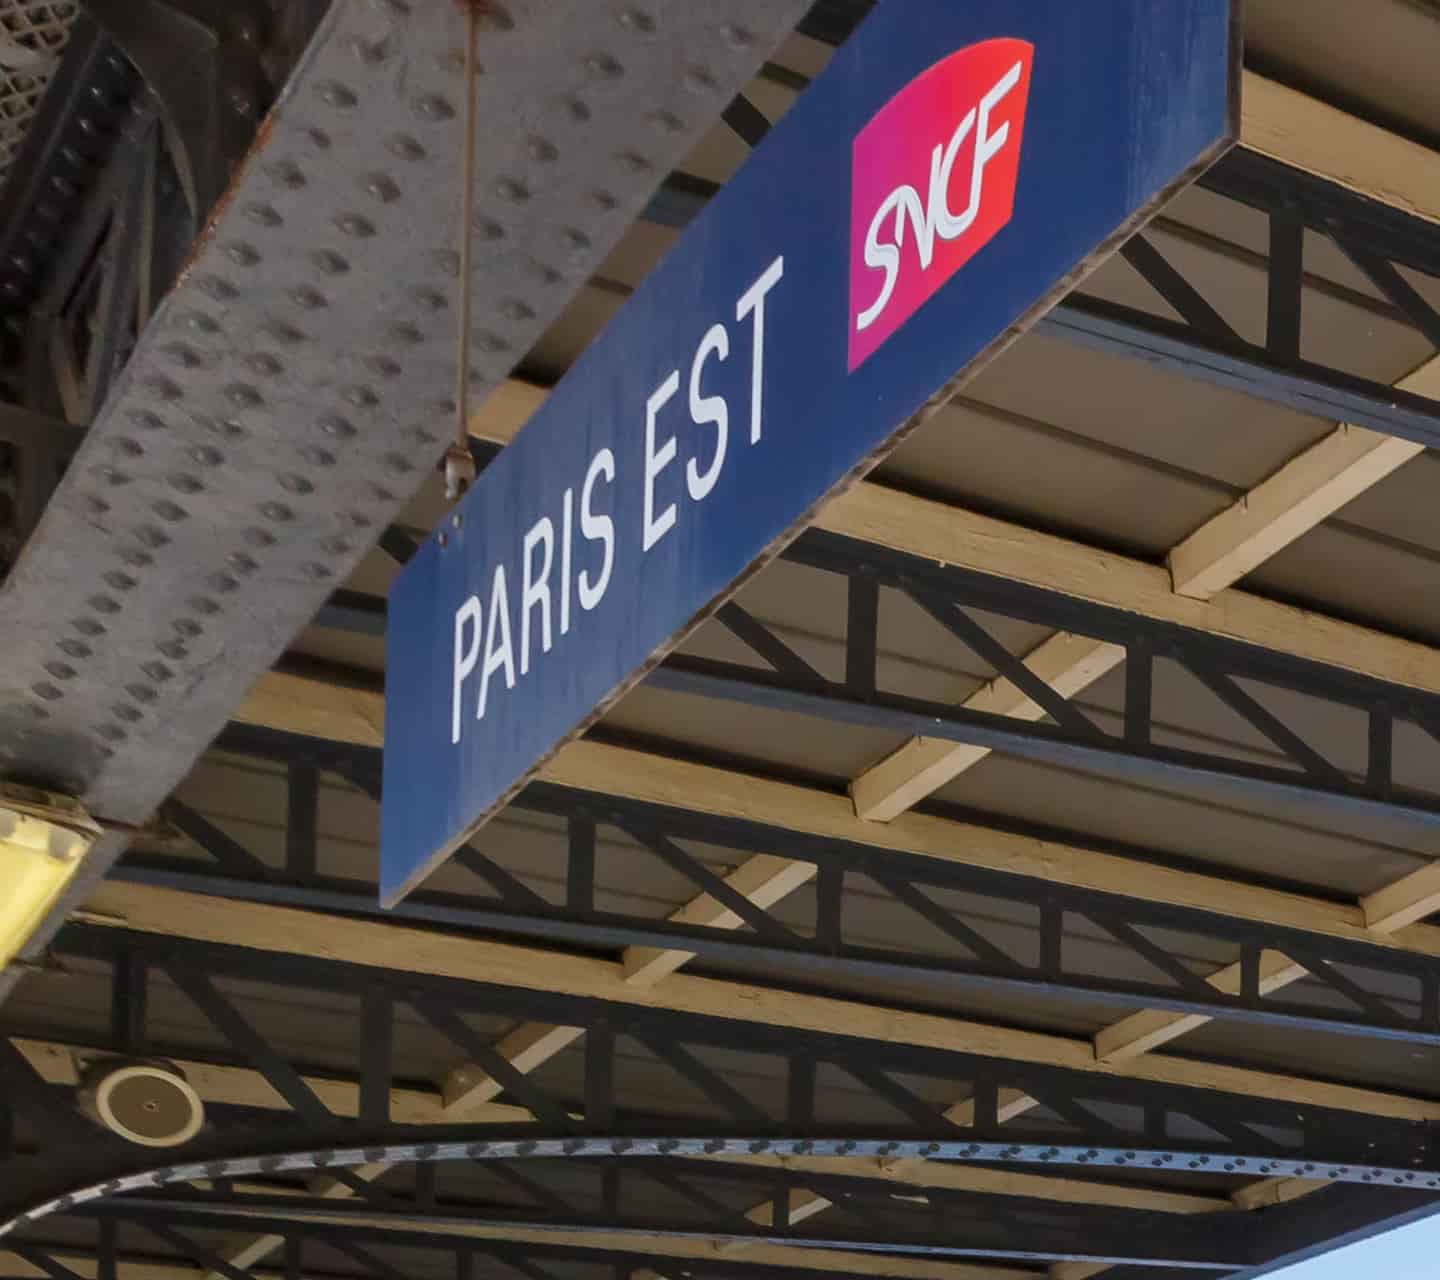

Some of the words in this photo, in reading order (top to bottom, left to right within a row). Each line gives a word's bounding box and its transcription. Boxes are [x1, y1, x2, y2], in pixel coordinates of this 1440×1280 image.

[855, 60, 1023, 332] SNCF
[451, 447, 616, 745] PARIS
[641, 255, 785, 553] EST
